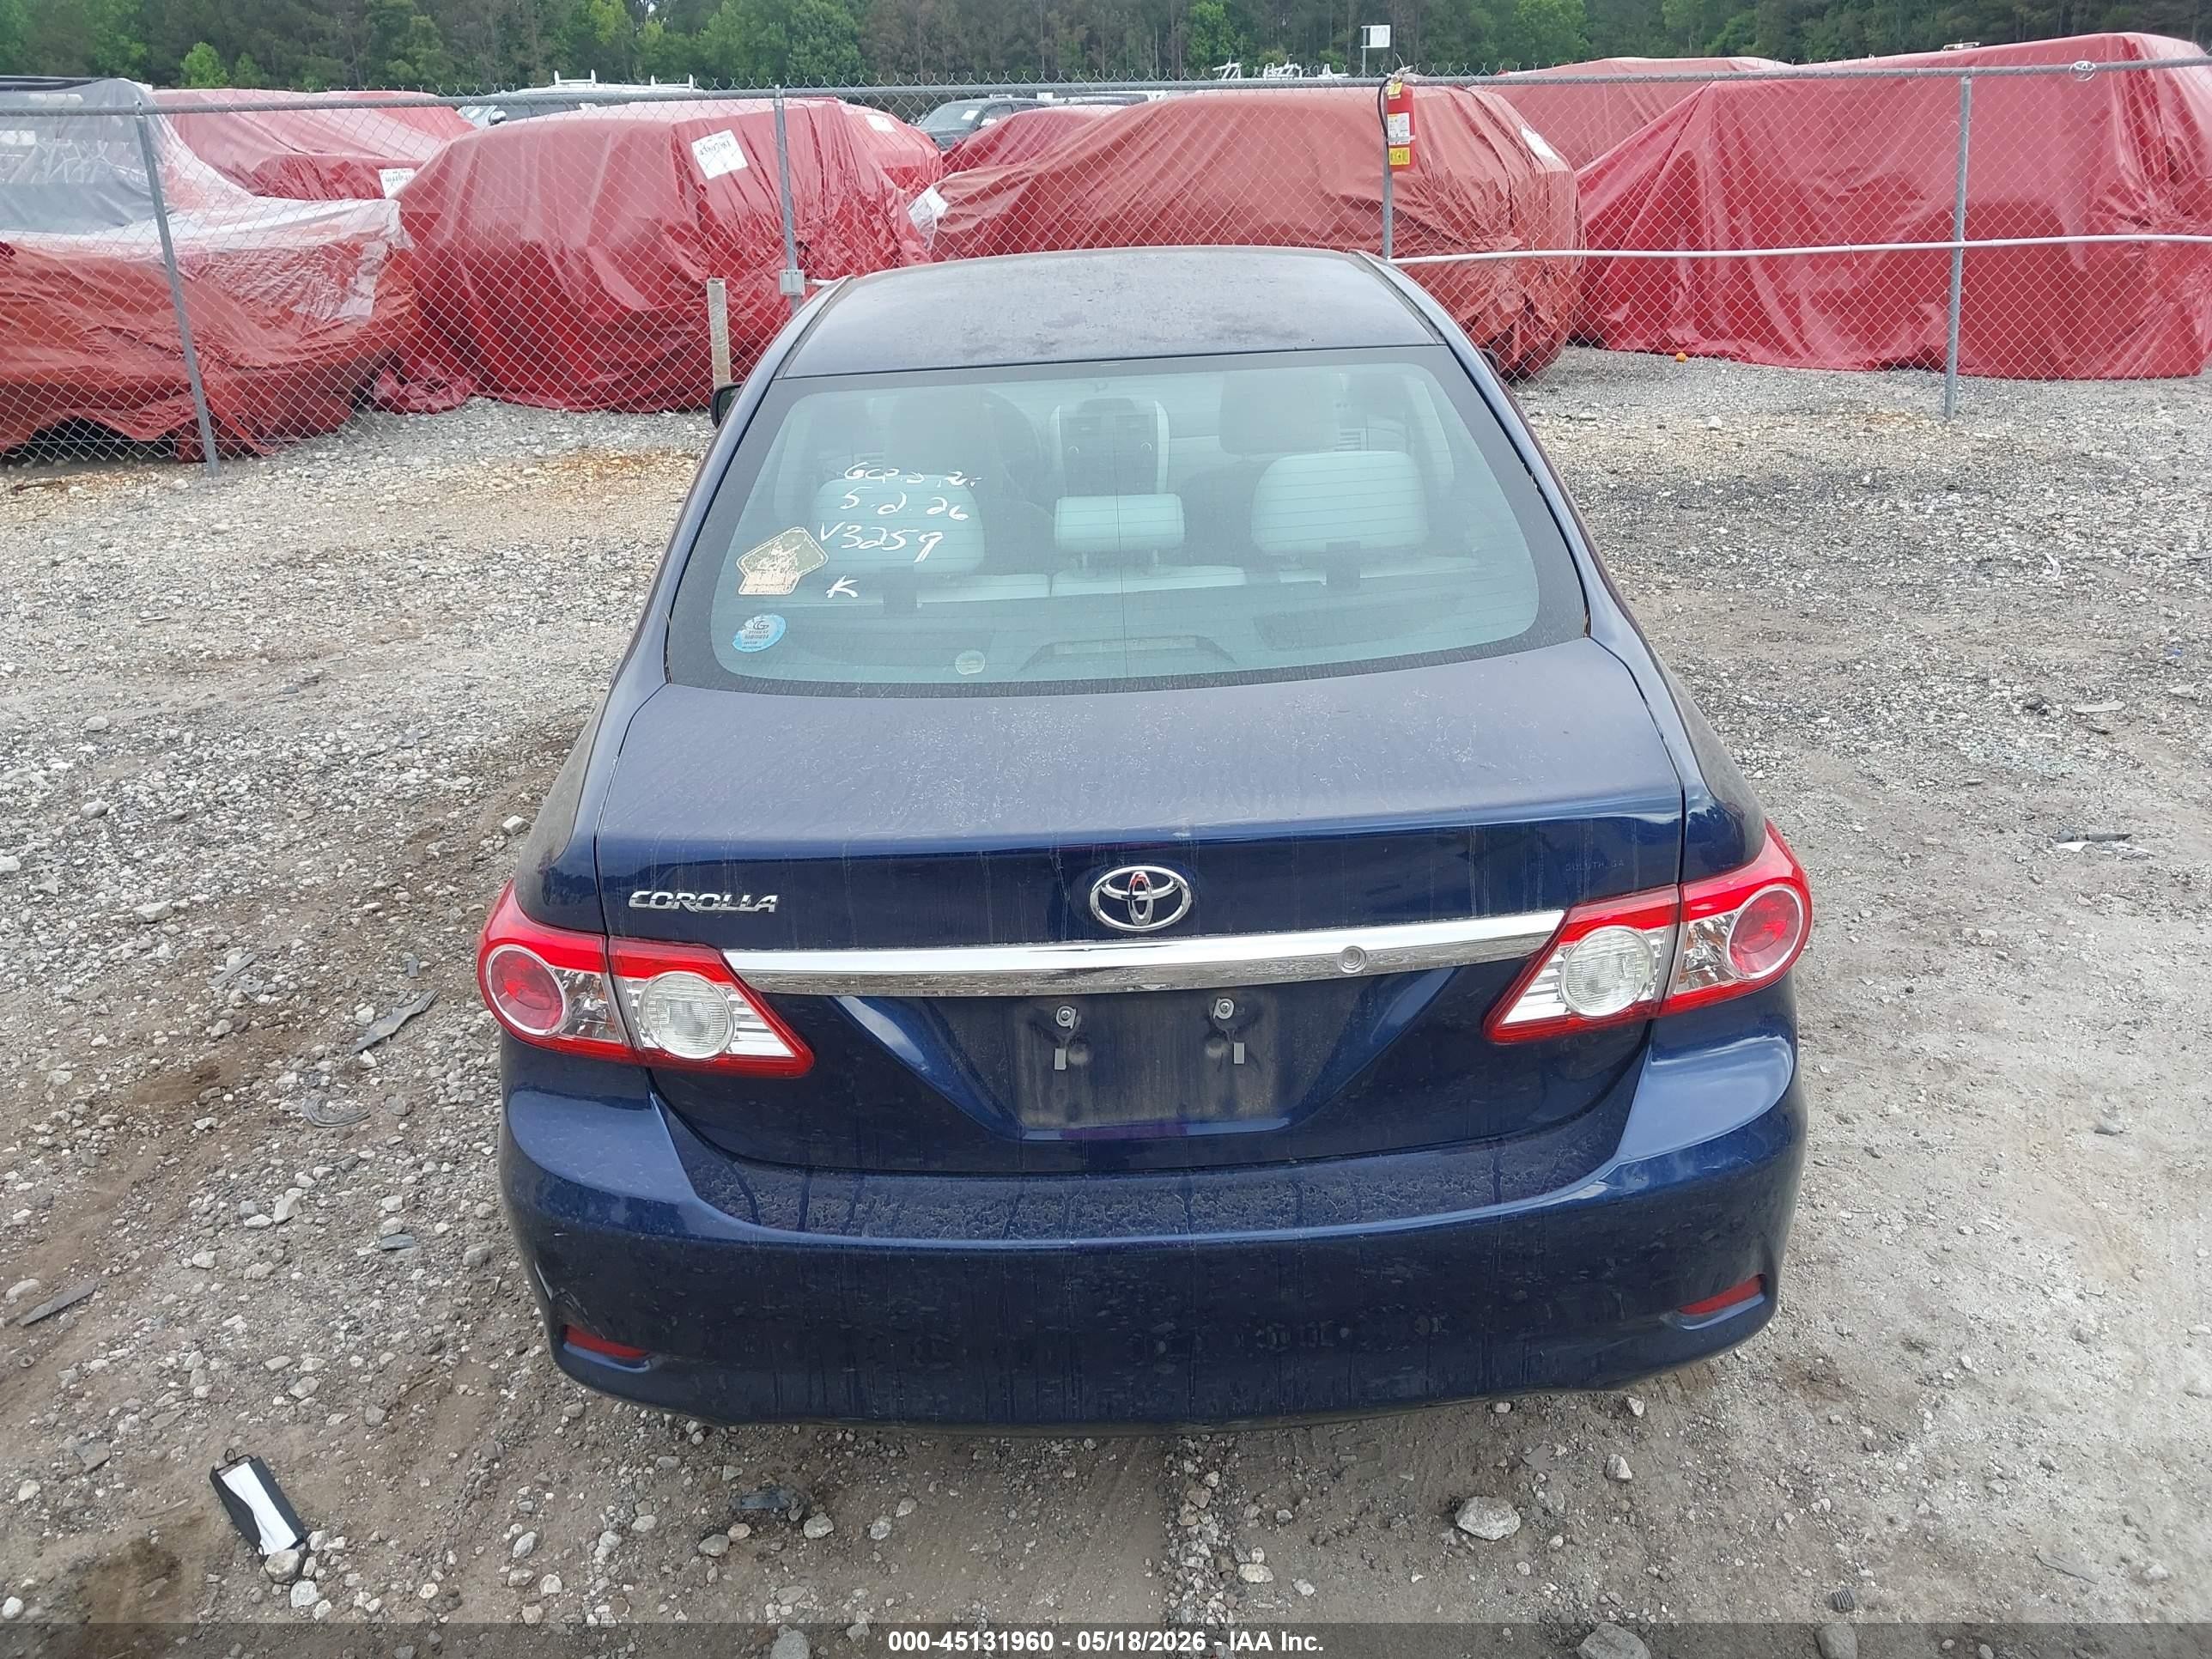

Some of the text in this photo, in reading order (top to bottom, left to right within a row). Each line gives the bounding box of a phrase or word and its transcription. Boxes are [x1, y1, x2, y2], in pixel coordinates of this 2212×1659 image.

[820, 521, 944, 563] V3259
[825, 574, 860, 599] K
[629, 890, 778, 913] COROLLA
